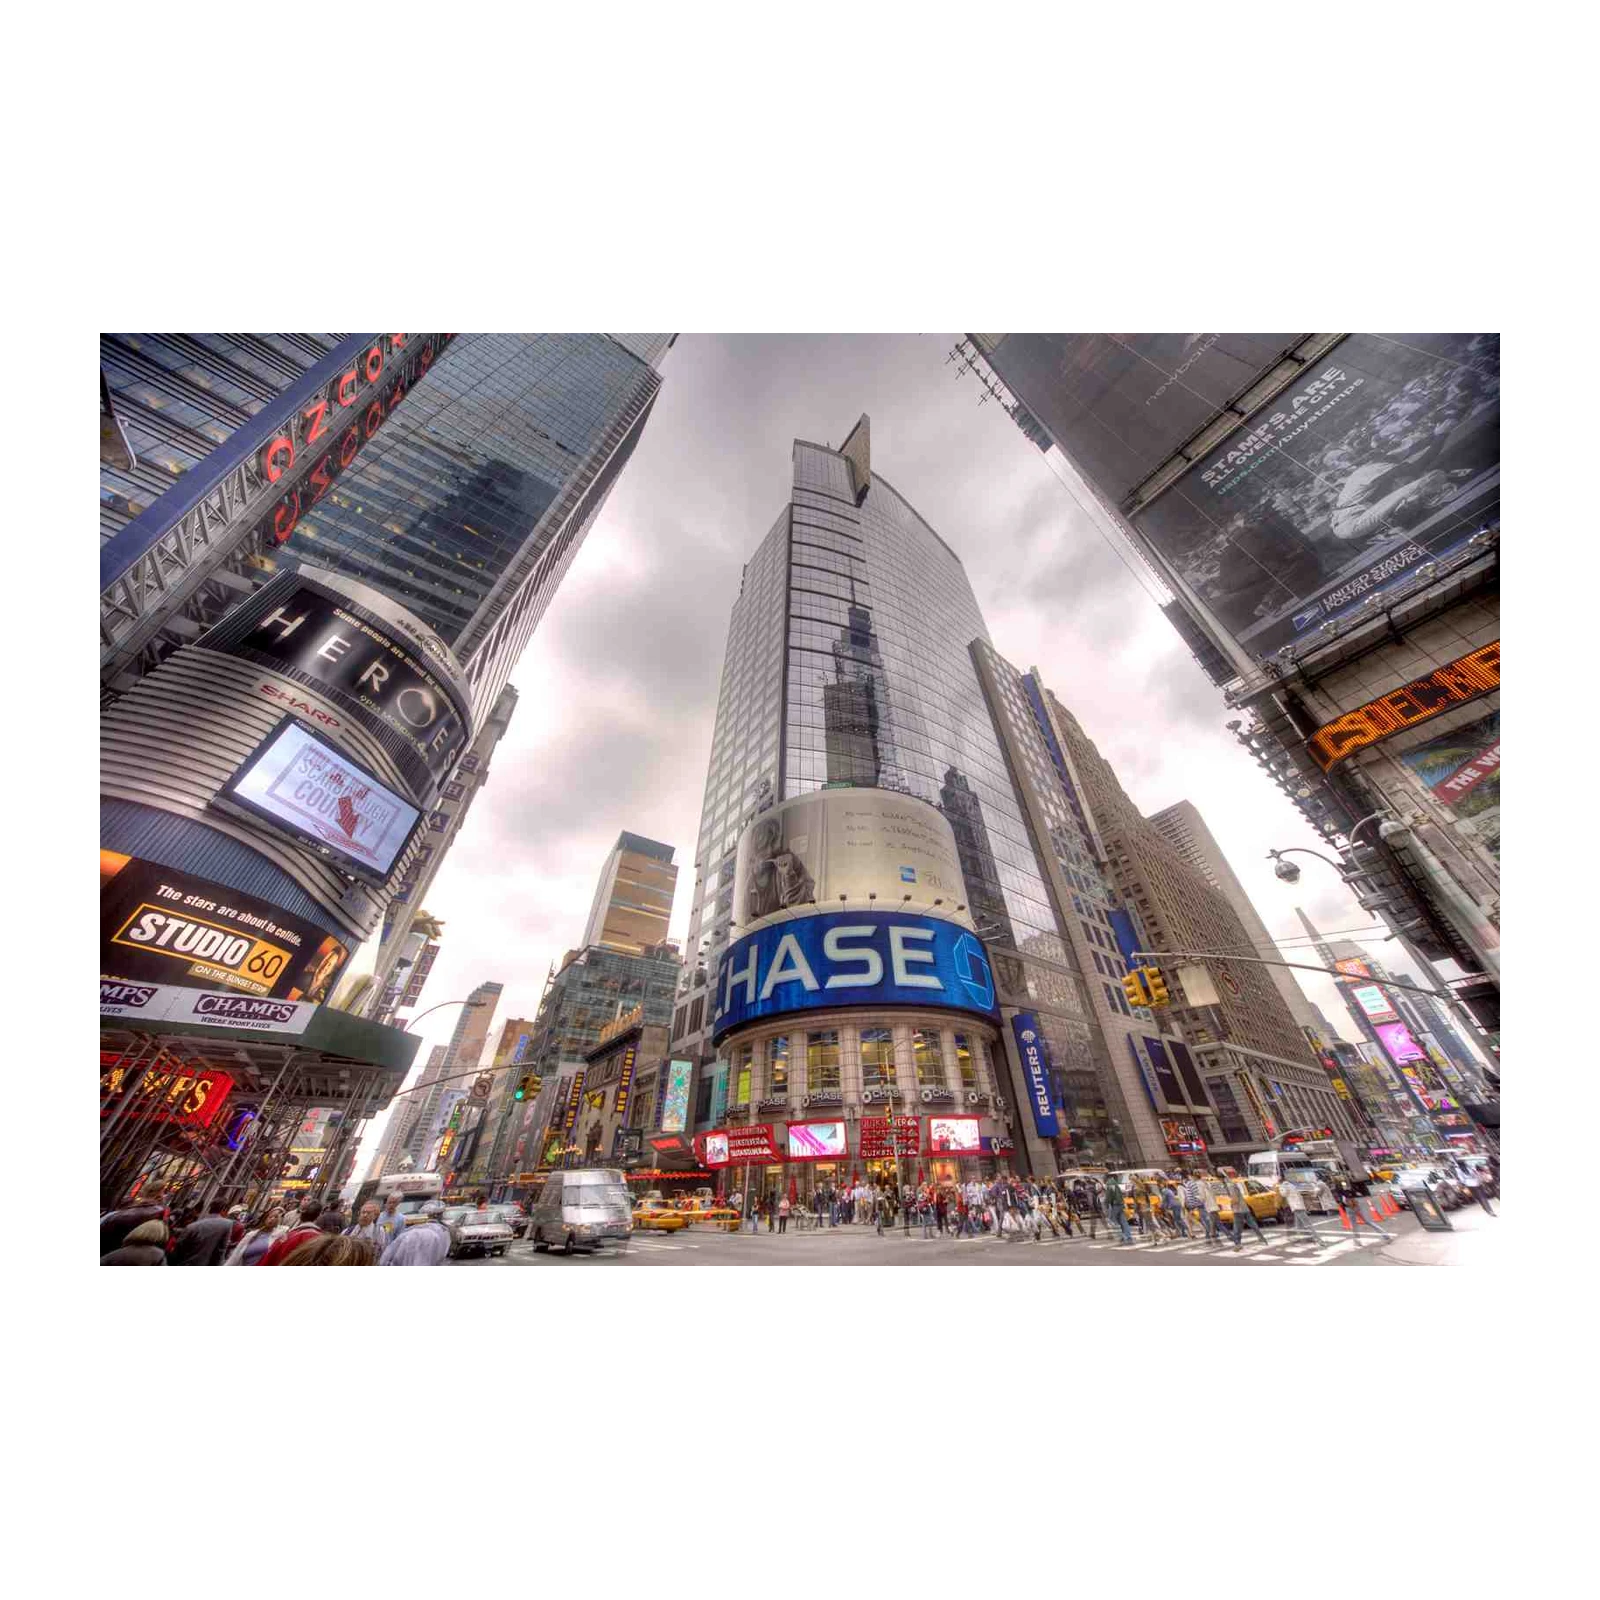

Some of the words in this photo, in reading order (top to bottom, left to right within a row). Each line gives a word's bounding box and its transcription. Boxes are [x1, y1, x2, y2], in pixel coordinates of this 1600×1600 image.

[1201, 412, 1287, 483] STAMPS
[1292, 366, 1346, 410] ARE
[1208, 464, 1235, 488] ALL
[1235, 431, 1276, 466] OVER
[1275, 404, 1309, 432] THE
[1307, 371, 1348, 405] CITY
[1217, 377, 1366, 495] usps.com/buystamps
[1323, 574, 1369, 605] UNITED
[1369, 544, 1419, 577] STATES
[1325, 581, 1372, 611] POSTAL
[1371, 549, 1429, 585] SERVICE
[333, 608, 361, 628] Some
[361, 626, 391, 649] people
[390, 644, 405, 658] are
[260, 684, 341, 728] SHARP
[261, 607, 457, 771] HEROES
[1444, 765, 1482, 792] THE
[156, 885, 182, 901] The
[183, 894, 216, 912] stars
[217, 905, 237, 919] are
[237, 911, 267, 929] about
[266, 920, 277, 933] to
[129, 912, 250, 966] STUDIO
[247, 950, 284, 979] 60
[715, 925, 945, 1017] HASE
[195, 966, 210, 976] ON
[211, 970, 226, 981] THE
[198, 996, 296, 1021] CHAMPS
[201, 1016, 226, 1026] WHERE
[250, 1021, 271, 1030] LIVES
[811, 1091, 843, 1102] CHASE
[1026, 1045, 1052, 1116] REUTERS
[861, 1148, 907, 1157] QUIKSILER
